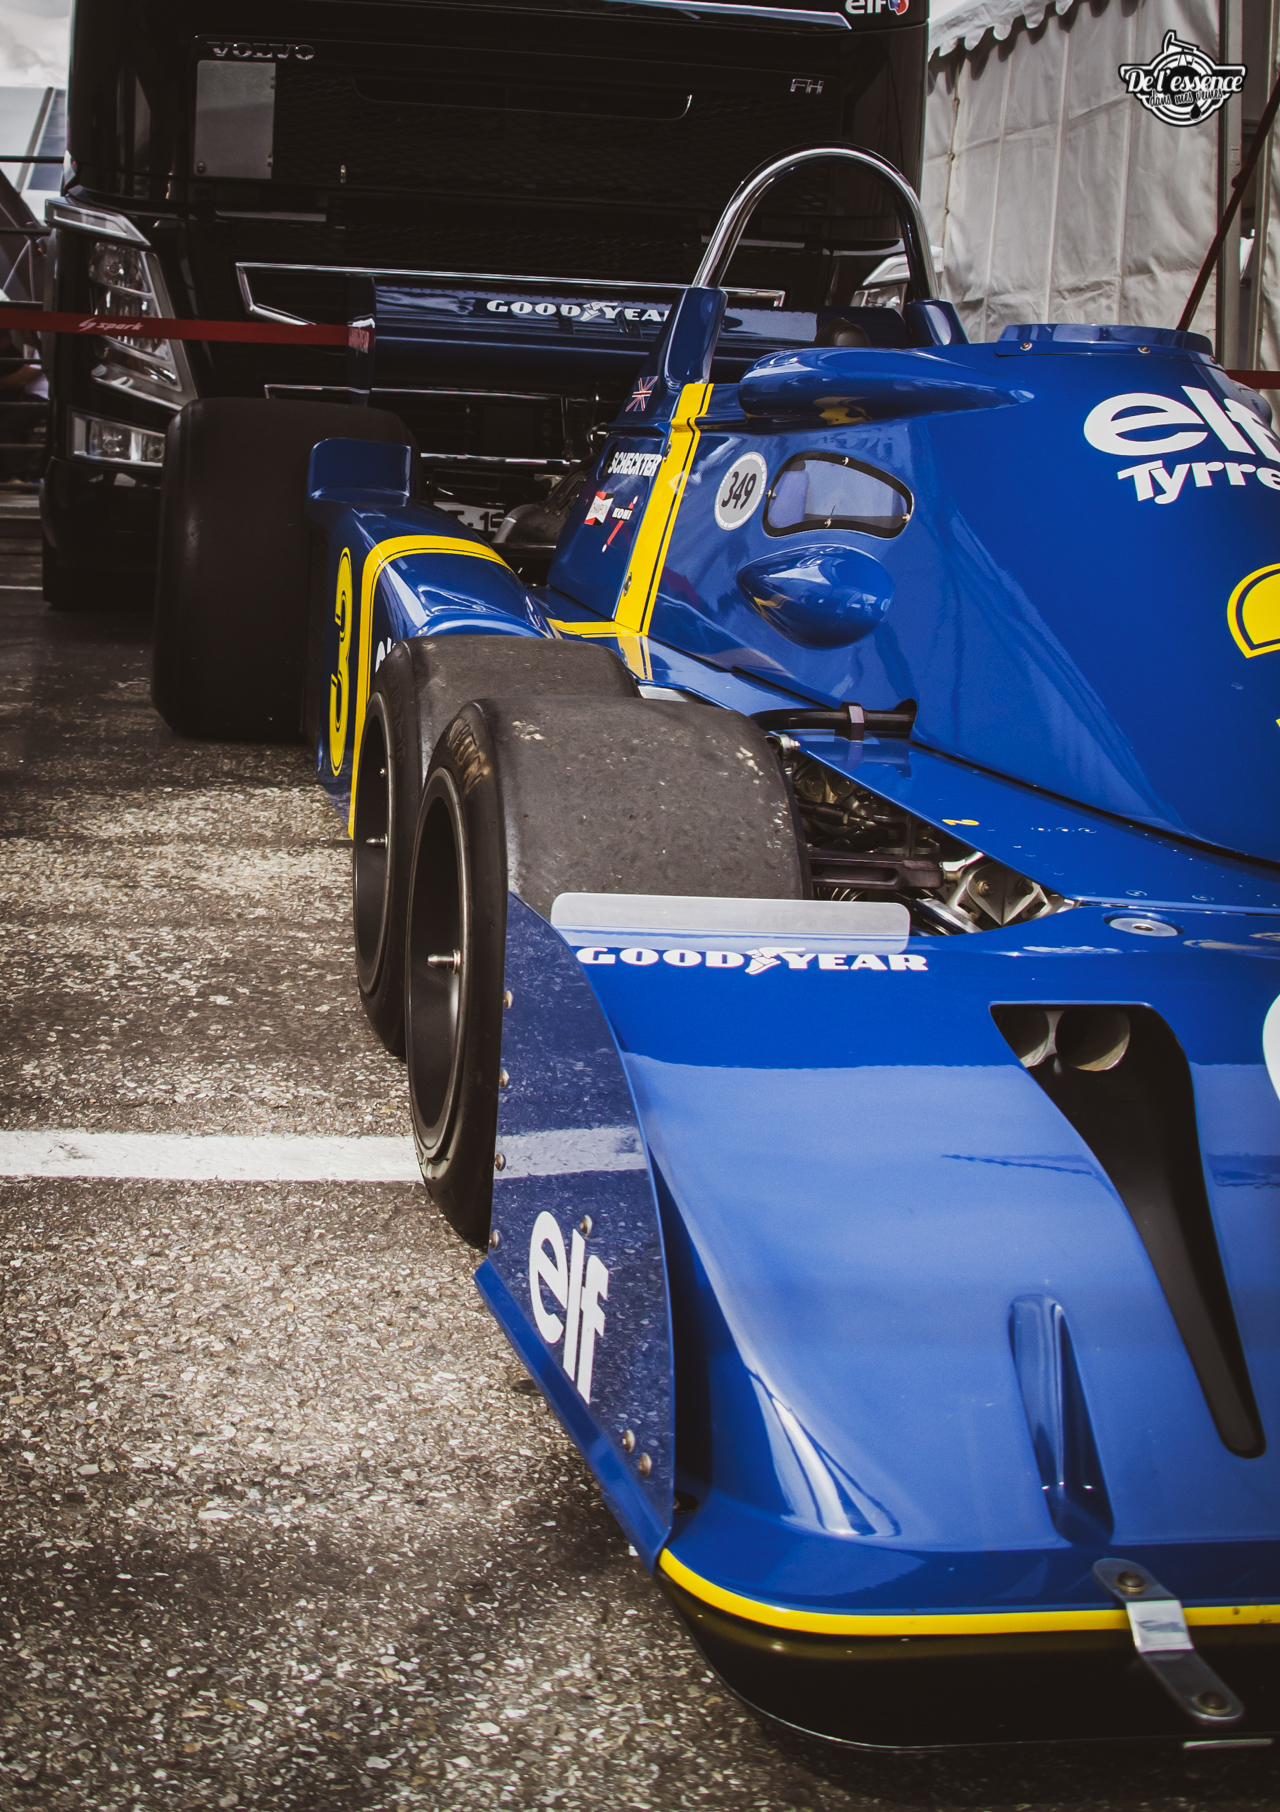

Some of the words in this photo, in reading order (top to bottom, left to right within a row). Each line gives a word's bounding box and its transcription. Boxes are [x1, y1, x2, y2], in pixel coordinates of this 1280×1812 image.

[206, 41, 315, 60] VOLVO
[790, 78, 824, 94] FH
[487, 300, 670, 322] GOODYEA
[1083, 385, 1280, 463] elf
[608, 452, 662, 477] SCHECKTER
[721, 471, 757, 510] 349
[329, 546, 353, 777] 3
[576, 946, 929, 975] GOODYEAR
[529, 1211, 609, 1404] elf
